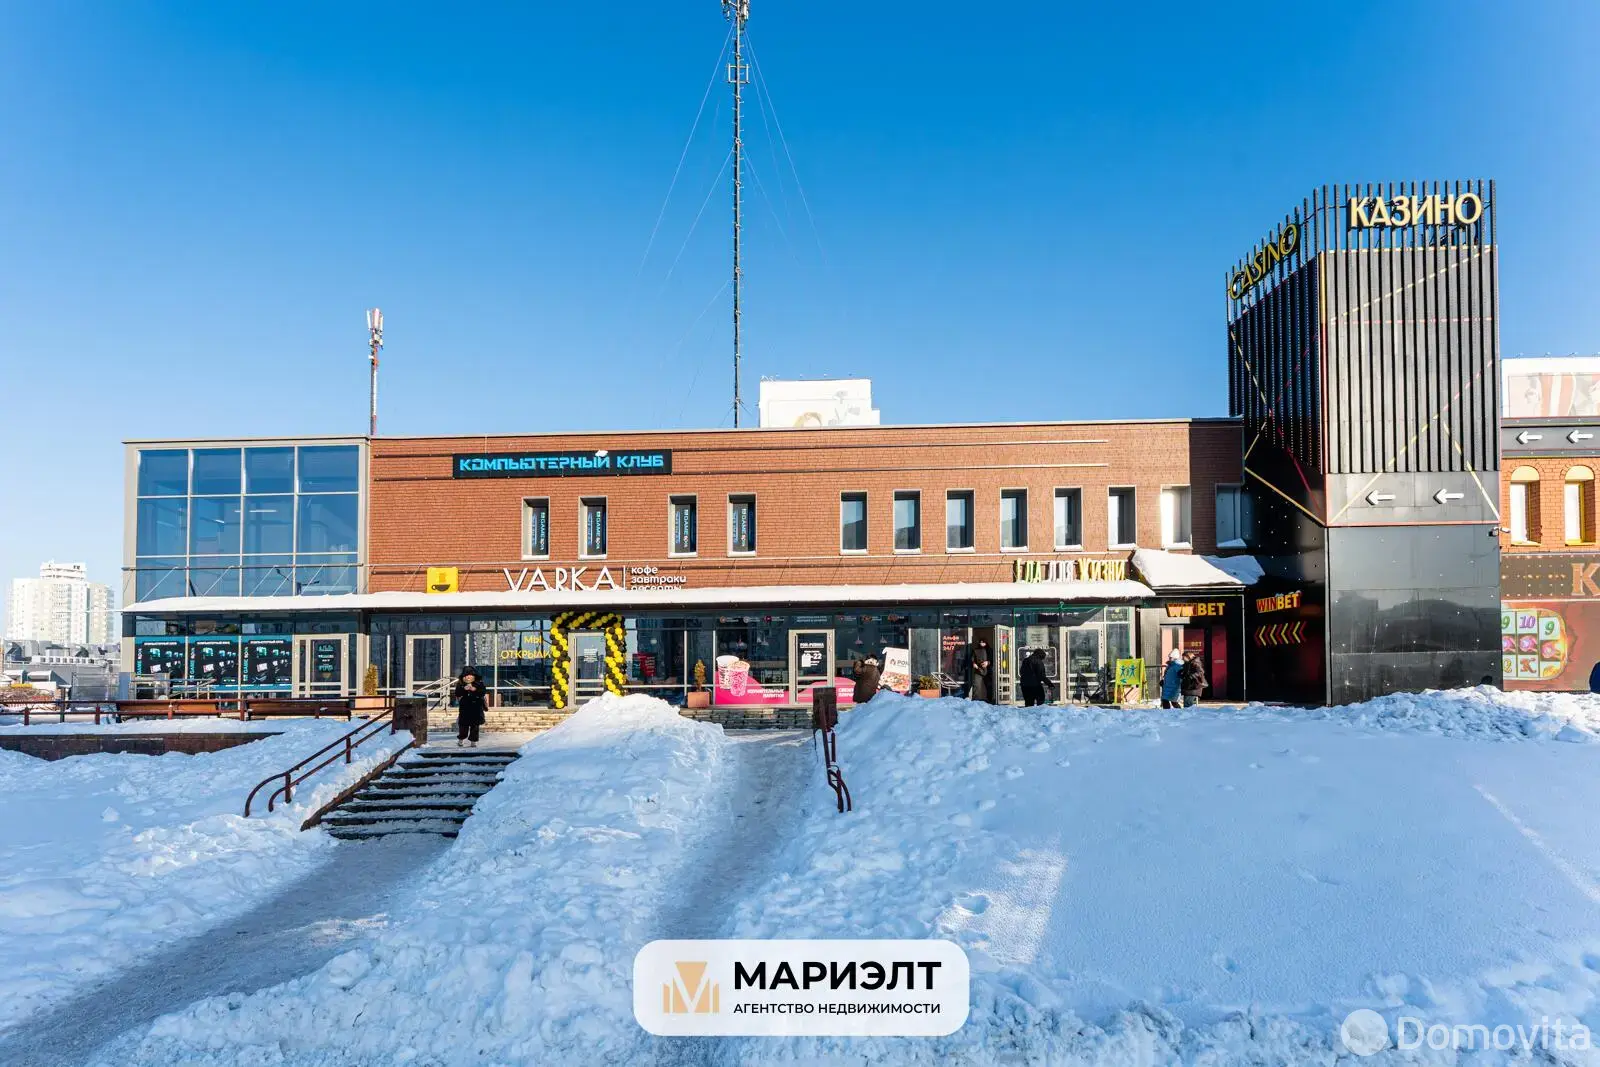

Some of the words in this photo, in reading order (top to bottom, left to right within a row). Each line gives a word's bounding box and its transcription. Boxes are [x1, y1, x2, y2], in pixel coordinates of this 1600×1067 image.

[1349, 193, 1482, 228] КАЗИНО
[1229, 223, 1297, 300] CASINO
[459, 455, 610, 472] КОМПЬЮТЕРНЫЙ
[616, 455, 664, 469] КЛУБ
[503, 566, 618, 592] VARKA
[631, 566, 659, 576] кофе
[631, 576, 687, 586] завтраки
[1167, 602, 1226, 617] WINBET
[1257, 593, 1300, 613] WINBET
[1519, 615, 1537, 629] 10
[1544, 621, 1555, 635] 9
[524, 635, 542, 644] МЫ
[500, 650, 551, 659] ОТКРЫЛИ
